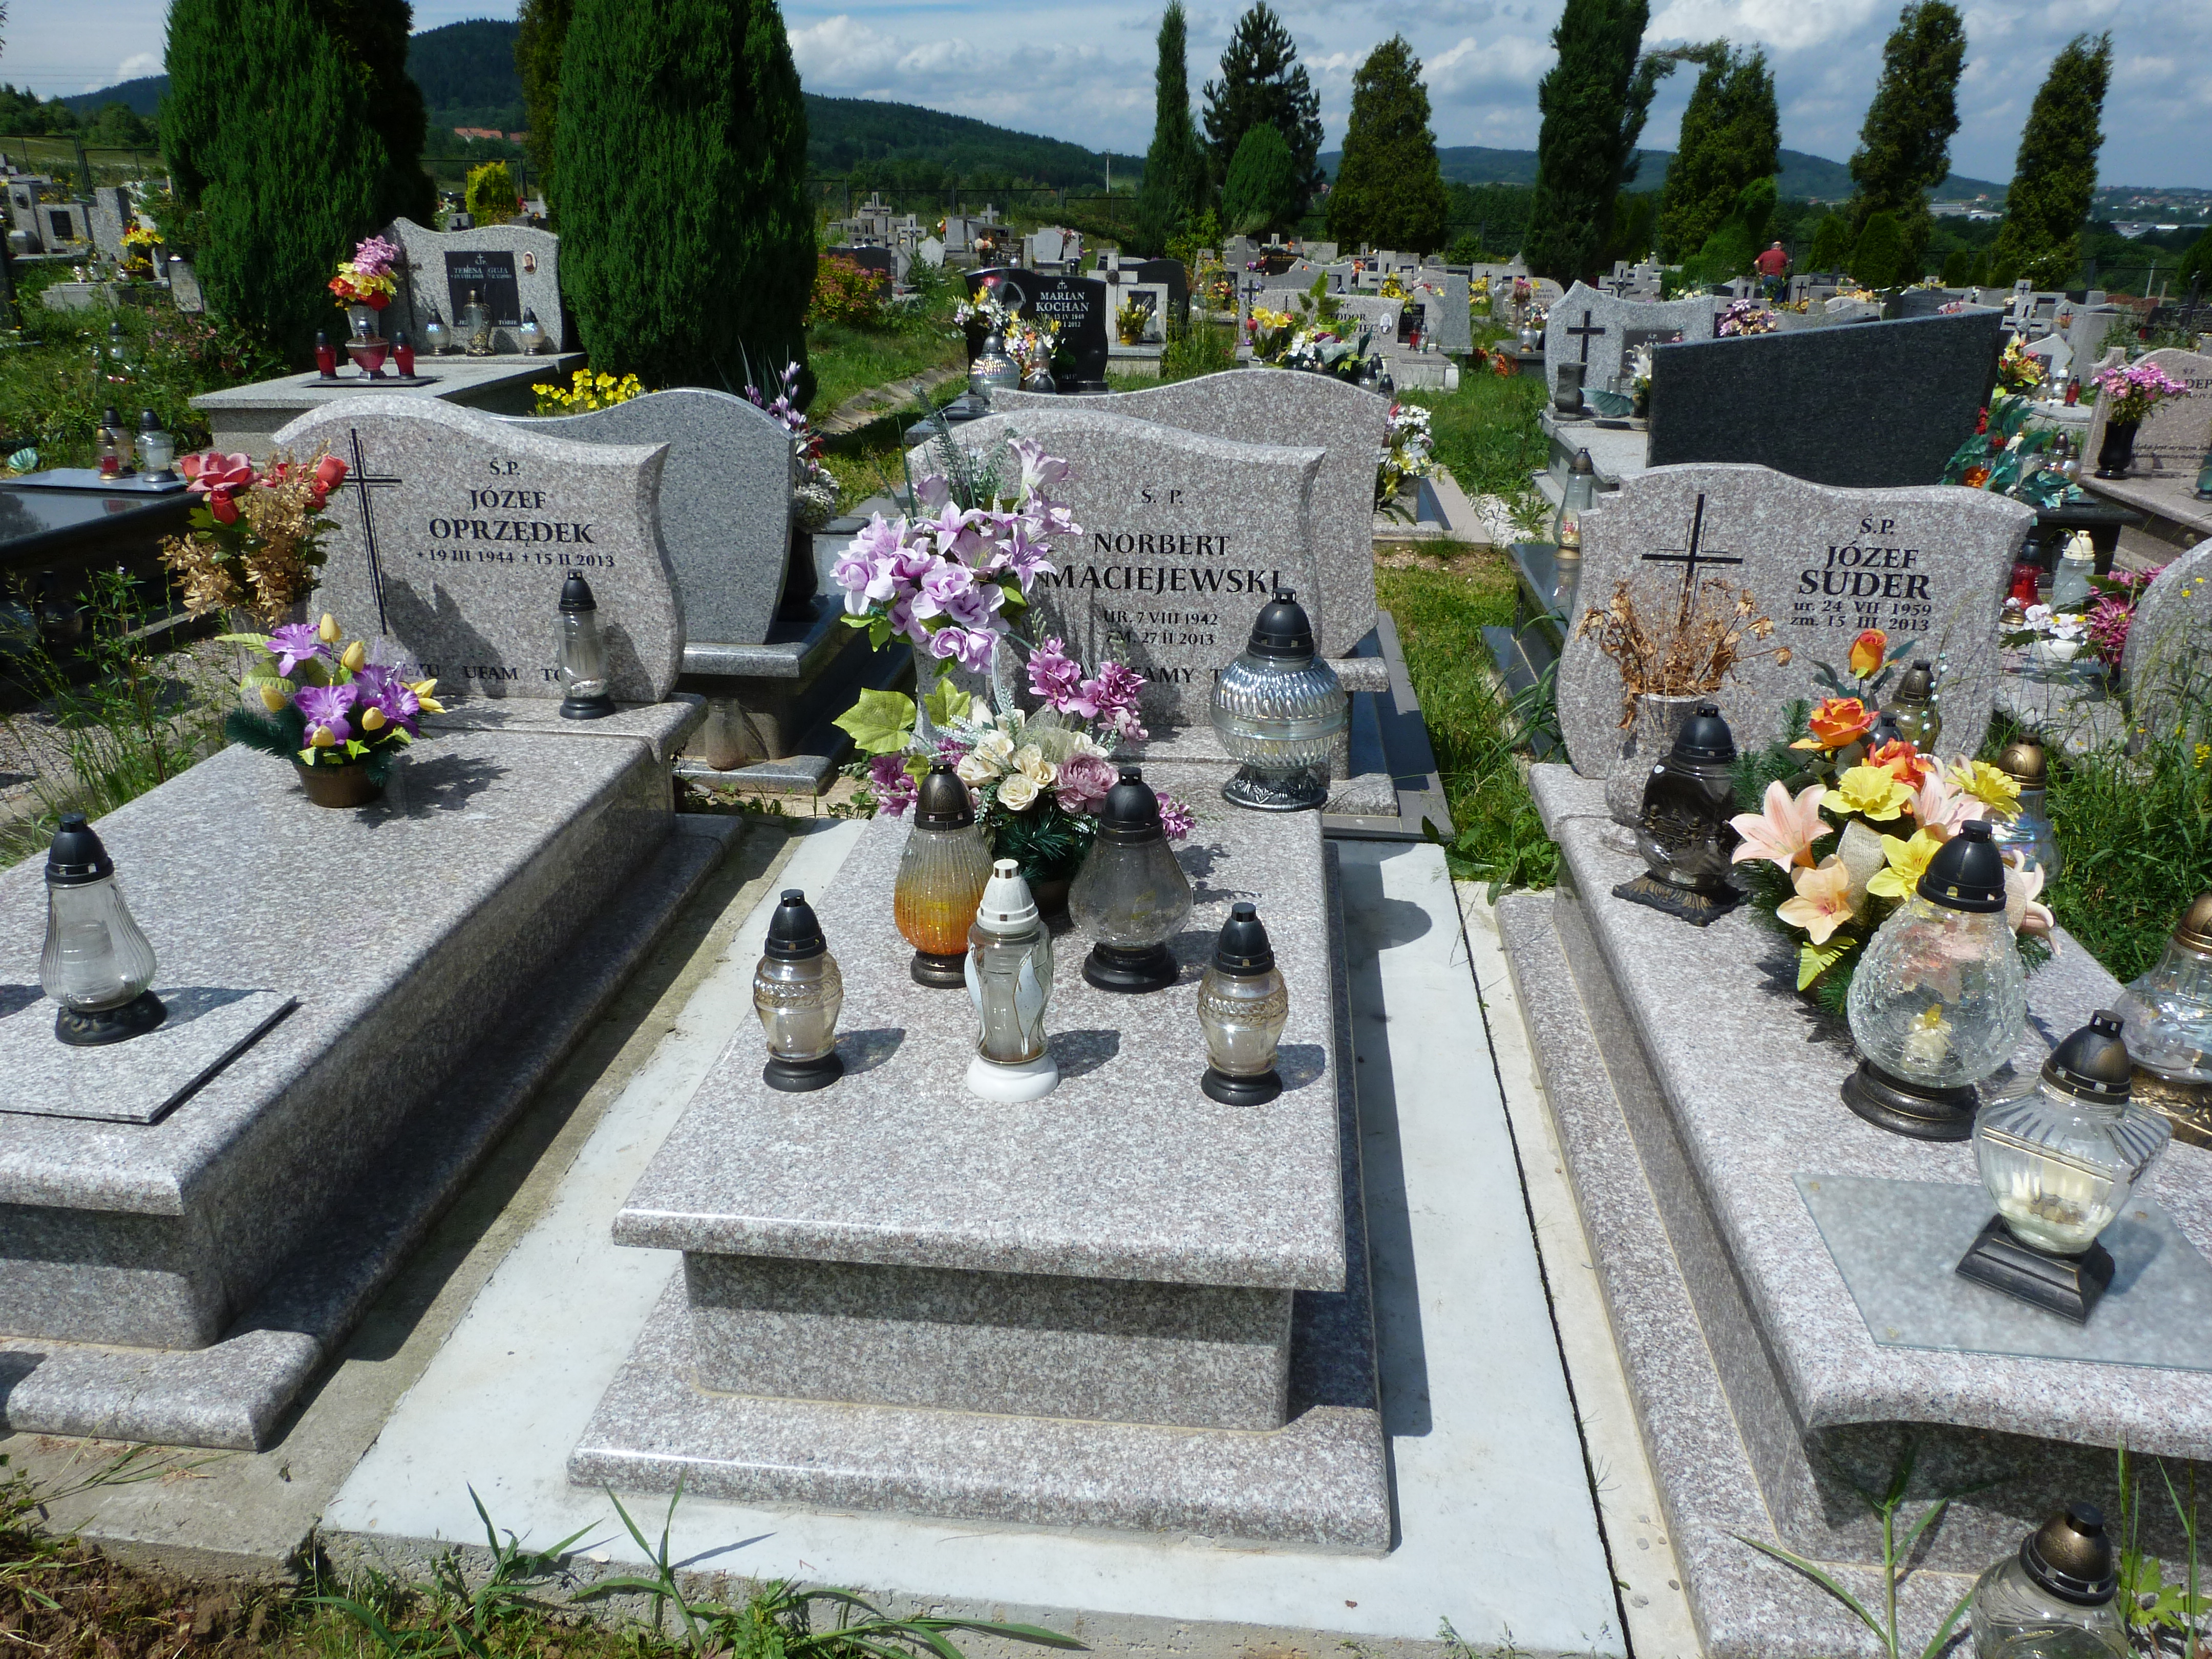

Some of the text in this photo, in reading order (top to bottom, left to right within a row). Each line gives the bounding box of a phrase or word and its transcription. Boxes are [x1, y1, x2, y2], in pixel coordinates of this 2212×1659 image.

[1040, 292, 1085, 301] MARIAN
[1036, 302, 1090, 312] KOCHAN
[490, 457, 520, 475] Ś.P.
[470, 485, 546, 511] JÓZEF
[429, 517, 596, 547] OPRZĘDEK
[1860, 513, 1895, 535] Ś.P.
[1095, 534, 1230, 556] NORBERT
[430, 549, 614, 567] 19 III 1944 15 II 2013
[1825, 540, 1919, 569] JÓZEF
[1045, 565, 1280, 594] MACIEJEWSKI
[1798, 569, 1931, 600] SUDER
[1794, 600, 1931, 616] ur. 24 VII 1959
[1103, 611, 1218, 625] UR. 7 VIII 1942
[1790, 615, 1929, 631] zm. 15 III 2013
[1142, 632, 1157, 644] 27
[1163, 633, 1174, 644] II
[1179, 633, 1214, 645] 2013
[463, 666, 519, 680] UFAM
